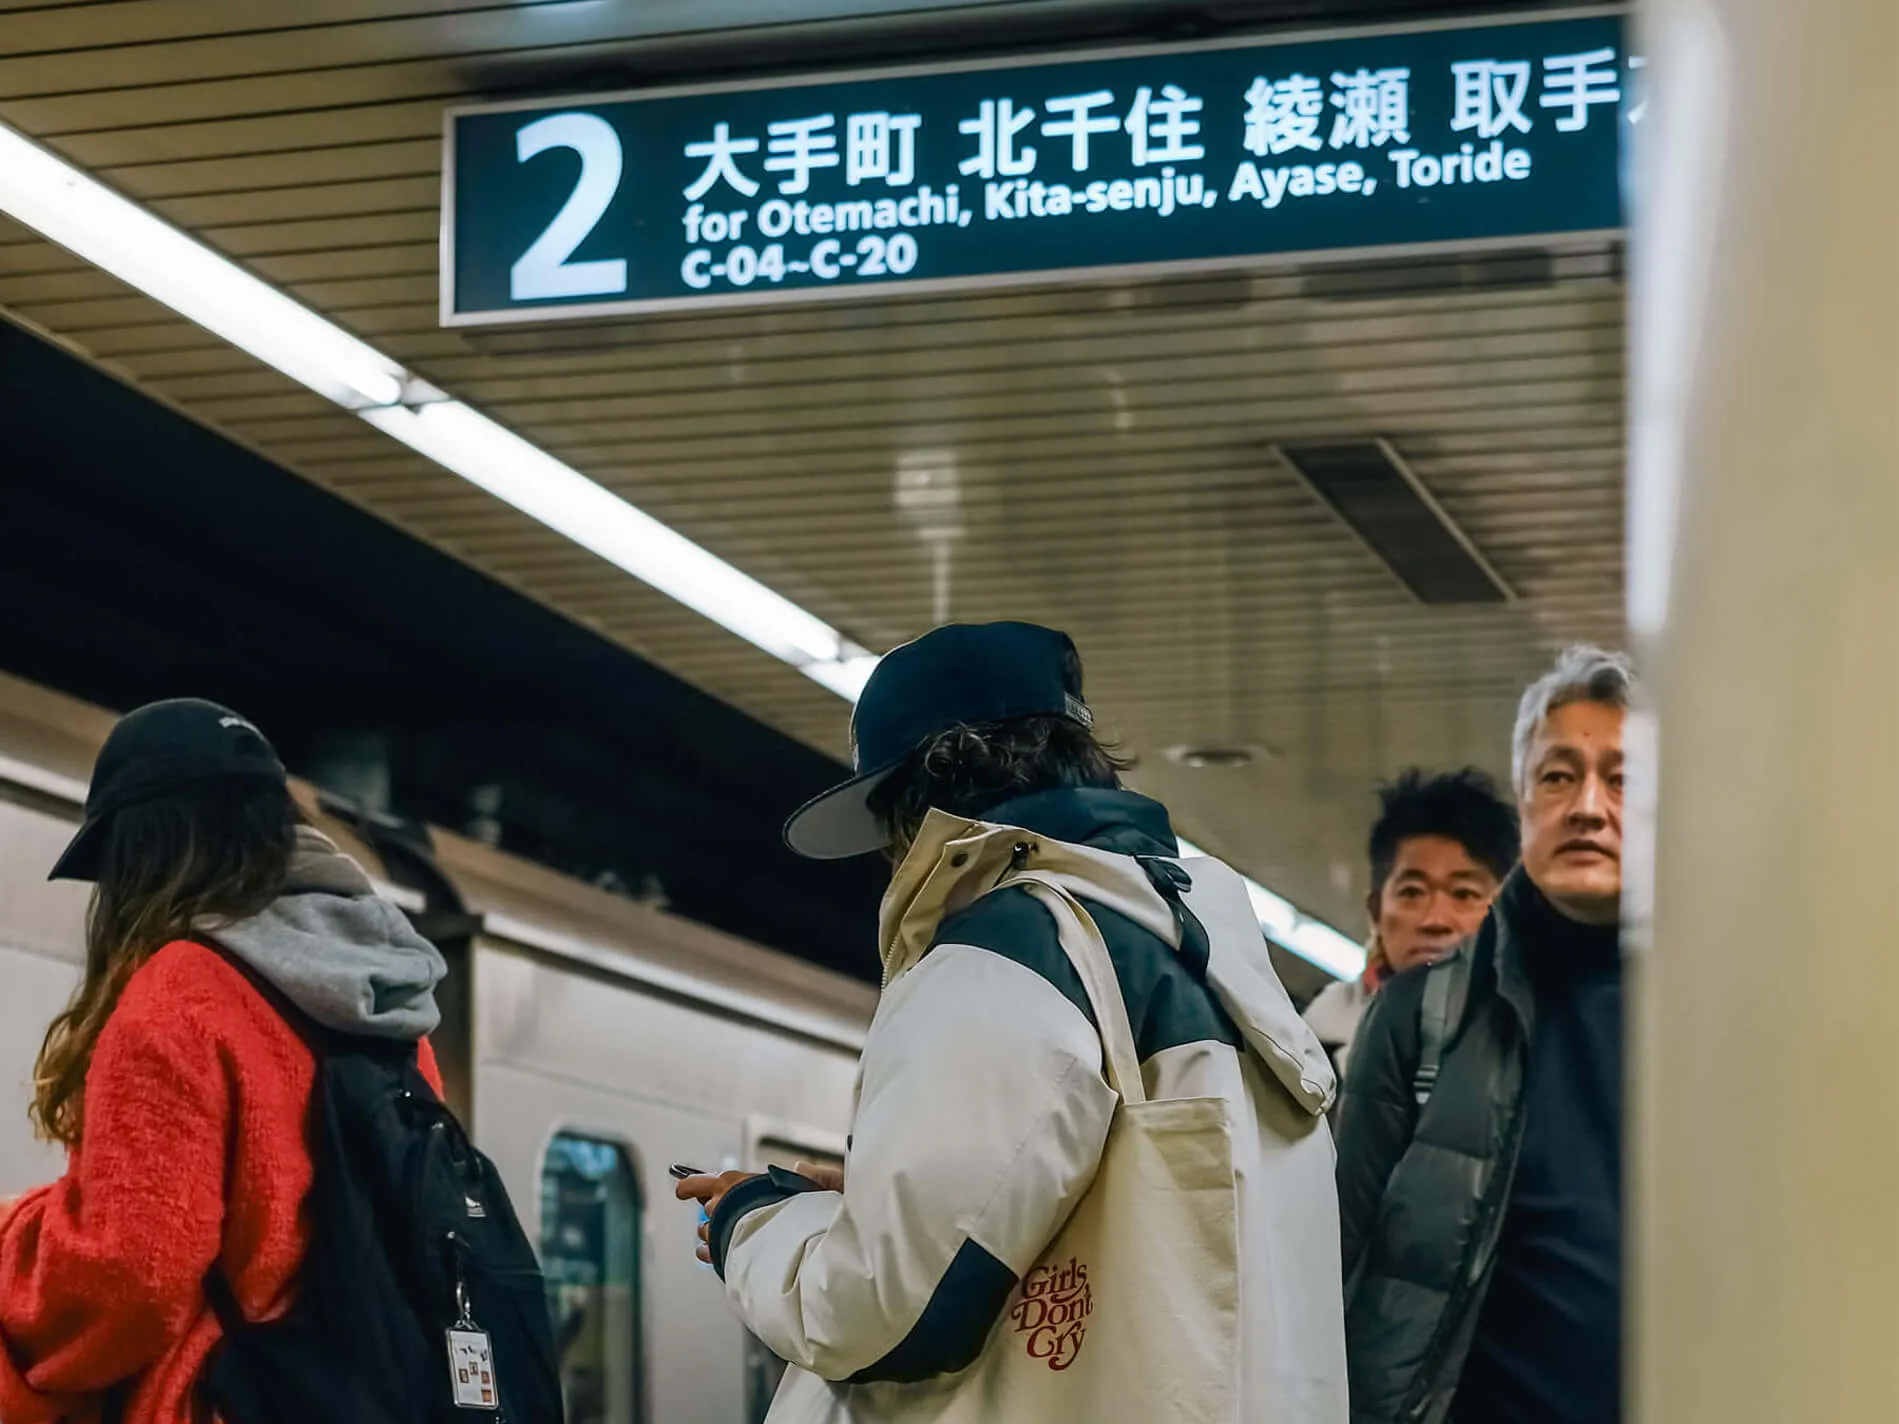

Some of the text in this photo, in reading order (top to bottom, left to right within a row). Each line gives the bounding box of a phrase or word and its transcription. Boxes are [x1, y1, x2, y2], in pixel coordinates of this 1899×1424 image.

[683, 48, 1621, 202] 大手町 北千住 綾瀬 取手
[511, 113, 627, 301] 2
[682, 141, 1531, 243] for Otemachi, Kita-senju, Ayase, Toride
[1022, 1256, 1088, 1303] Girls
[1026, 1321, 1086, 1371] Cry
